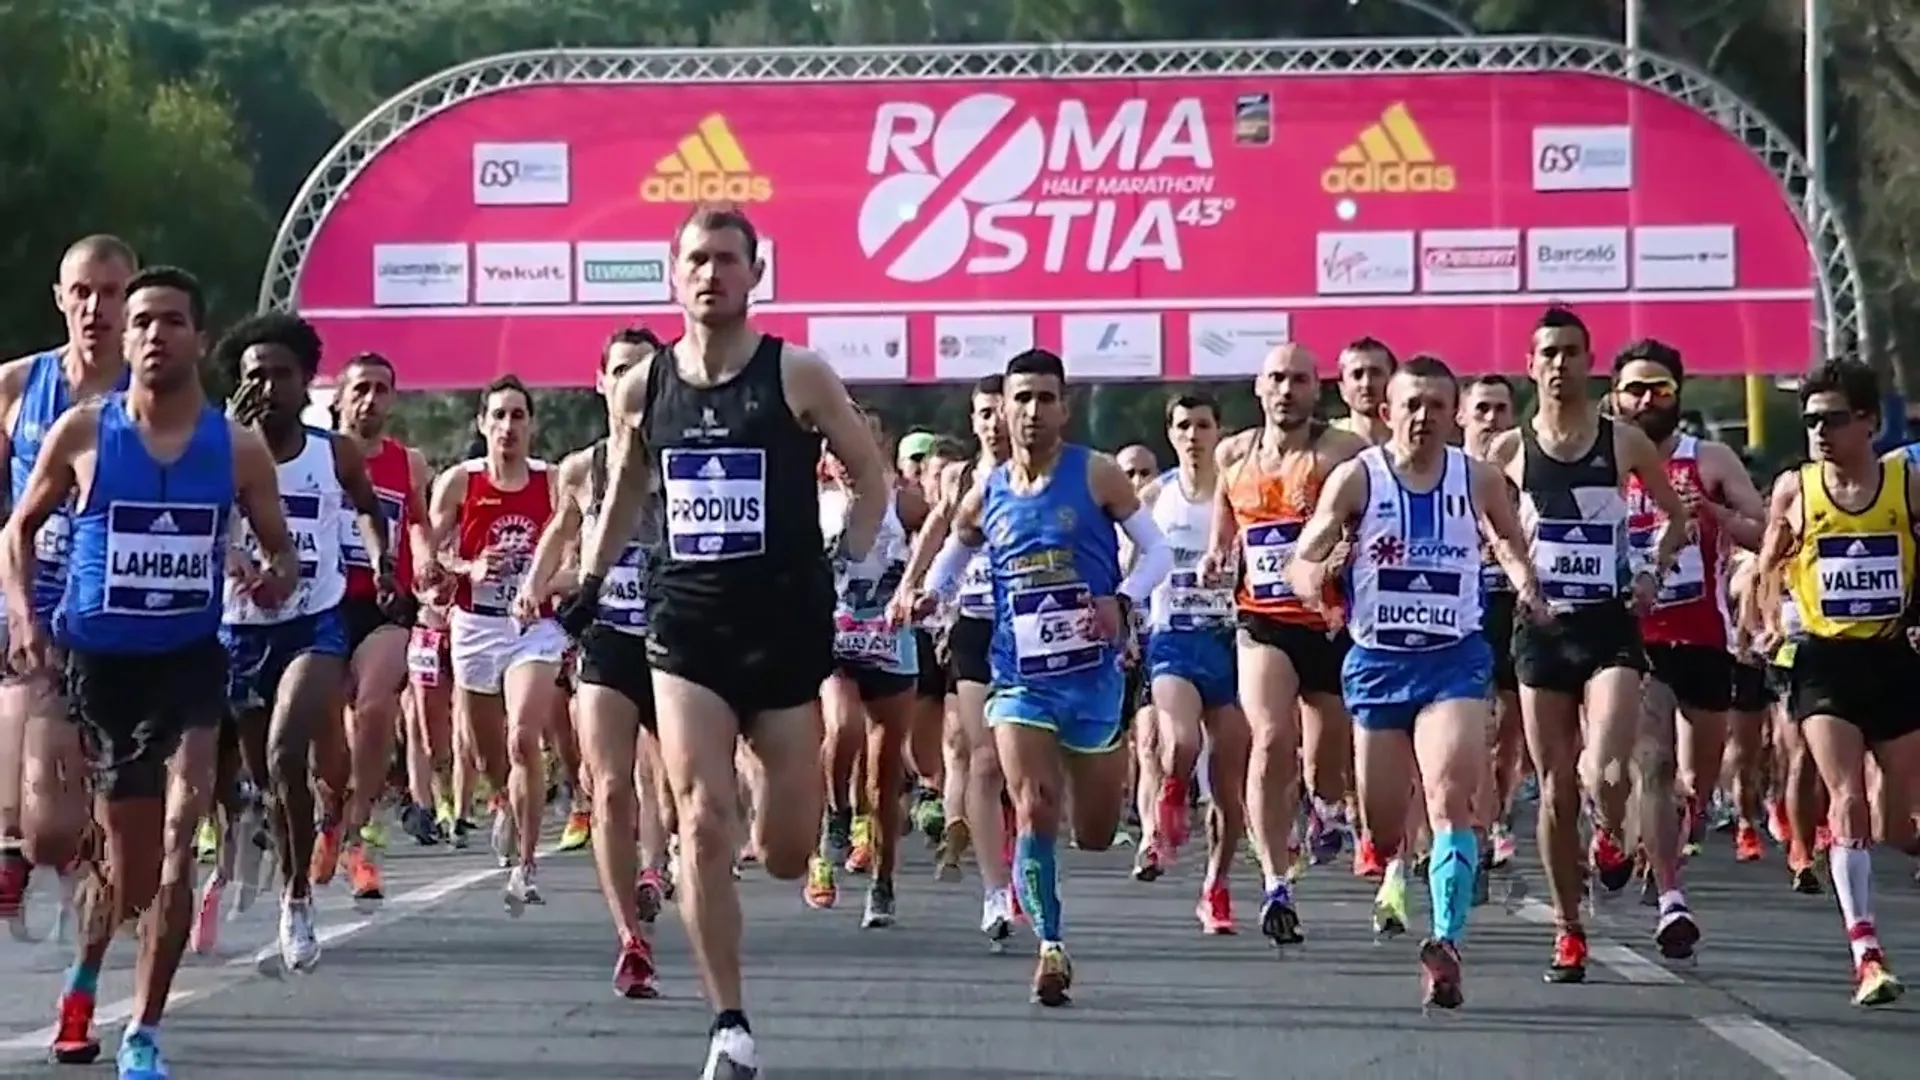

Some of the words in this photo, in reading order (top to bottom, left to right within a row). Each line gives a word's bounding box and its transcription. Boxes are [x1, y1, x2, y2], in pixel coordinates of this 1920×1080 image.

[867, 93, 1213, 203] ROMA
[641, 172, 773, 203] adidas
[1041, 176, 1094, 195] HALF
[1096, 175, 1215, 194] MARATHON
[1321, 162, 1456, 192] adidas
[858, 172, 1183, 282] OSTIA
[1537, 245, 1616, 262] Barceló
[483, 265, 565, 281] Yakult
[672, 496, 760, 522] PRODIUS
[113, 551, 208, 578] LAHBABI
[1550, 555, 1601, 576] JBARI
[1822, 568, 1899, 591] VALENTI
[1377, 604, 1457, 628] BUCCILLI
